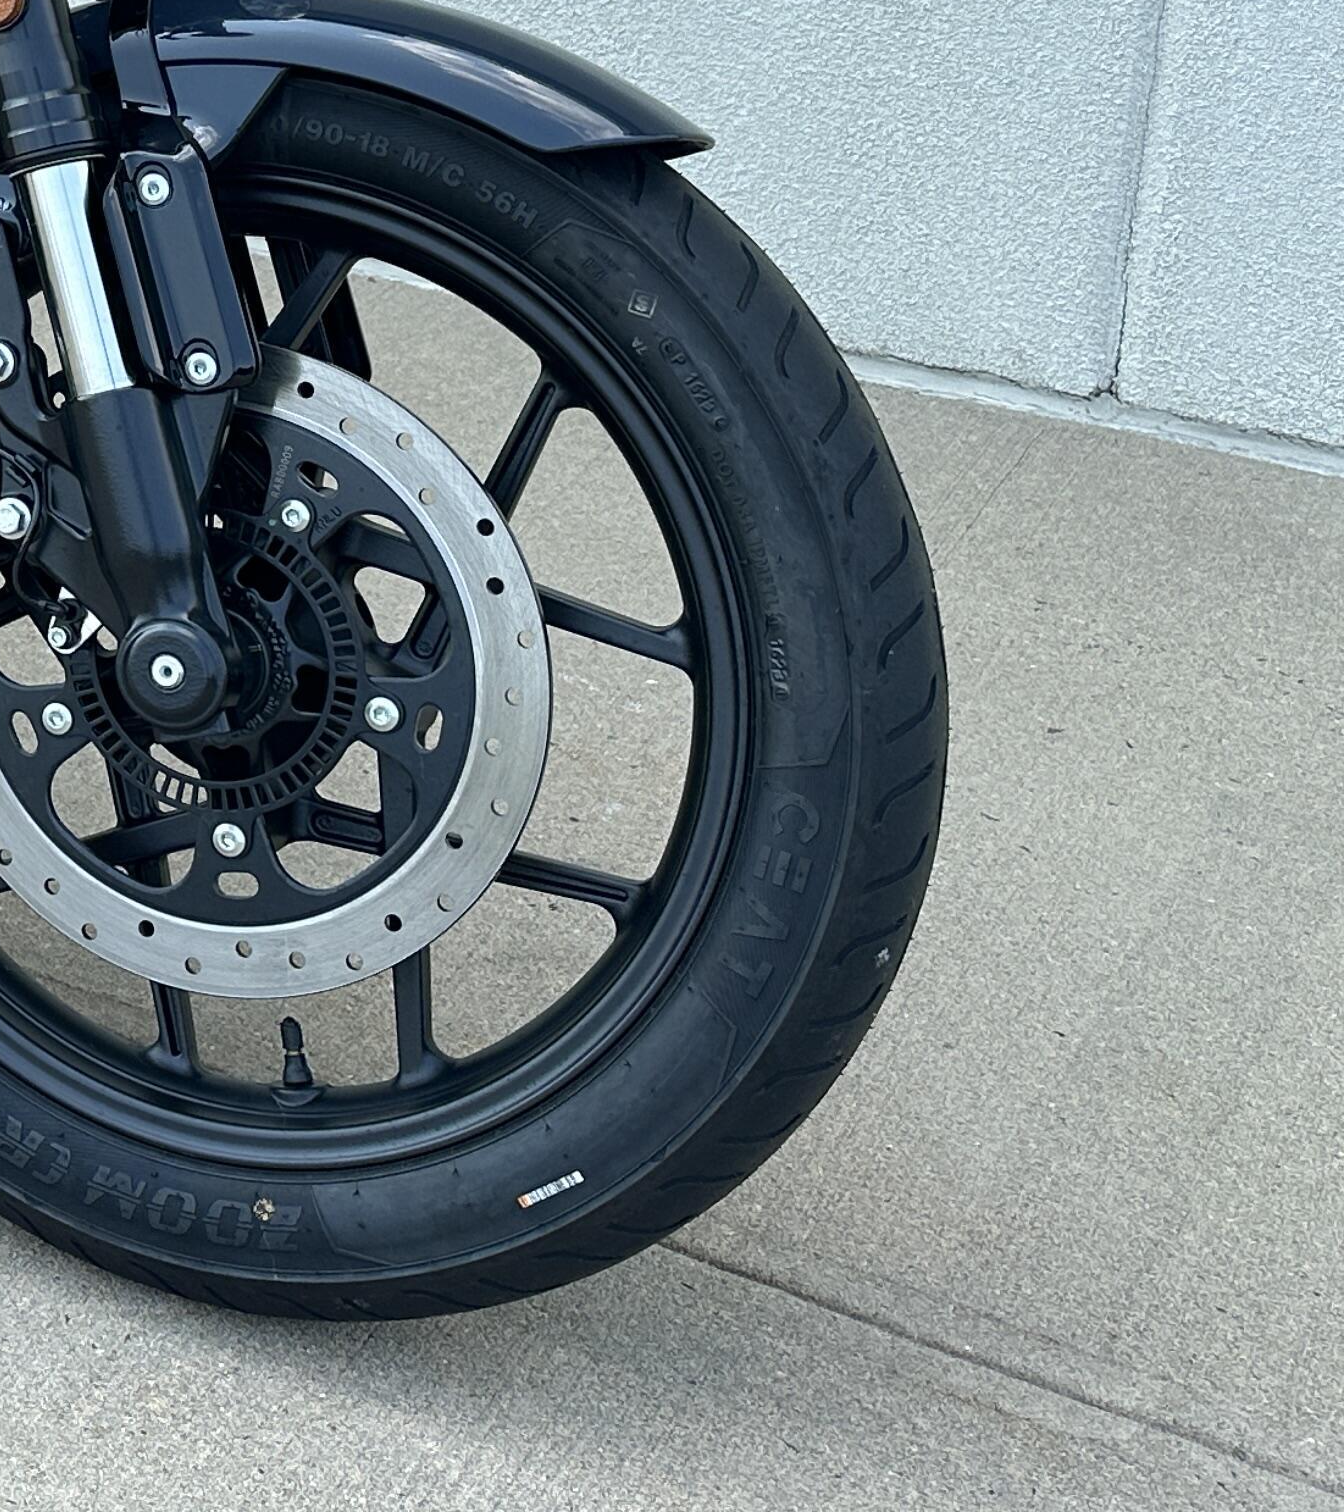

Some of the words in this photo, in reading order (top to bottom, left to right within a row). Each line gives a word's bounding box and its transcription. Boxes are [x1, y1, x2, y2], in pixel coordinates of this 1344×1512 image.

[270, 114, 391, 159] 0/90-18
[400, 145, 466, 188] M/C
[474, 180, 540, 229] 56H
[717, 789, 821, 1001] CEAT
[83, 1164, 305, 1252] ZOOM
